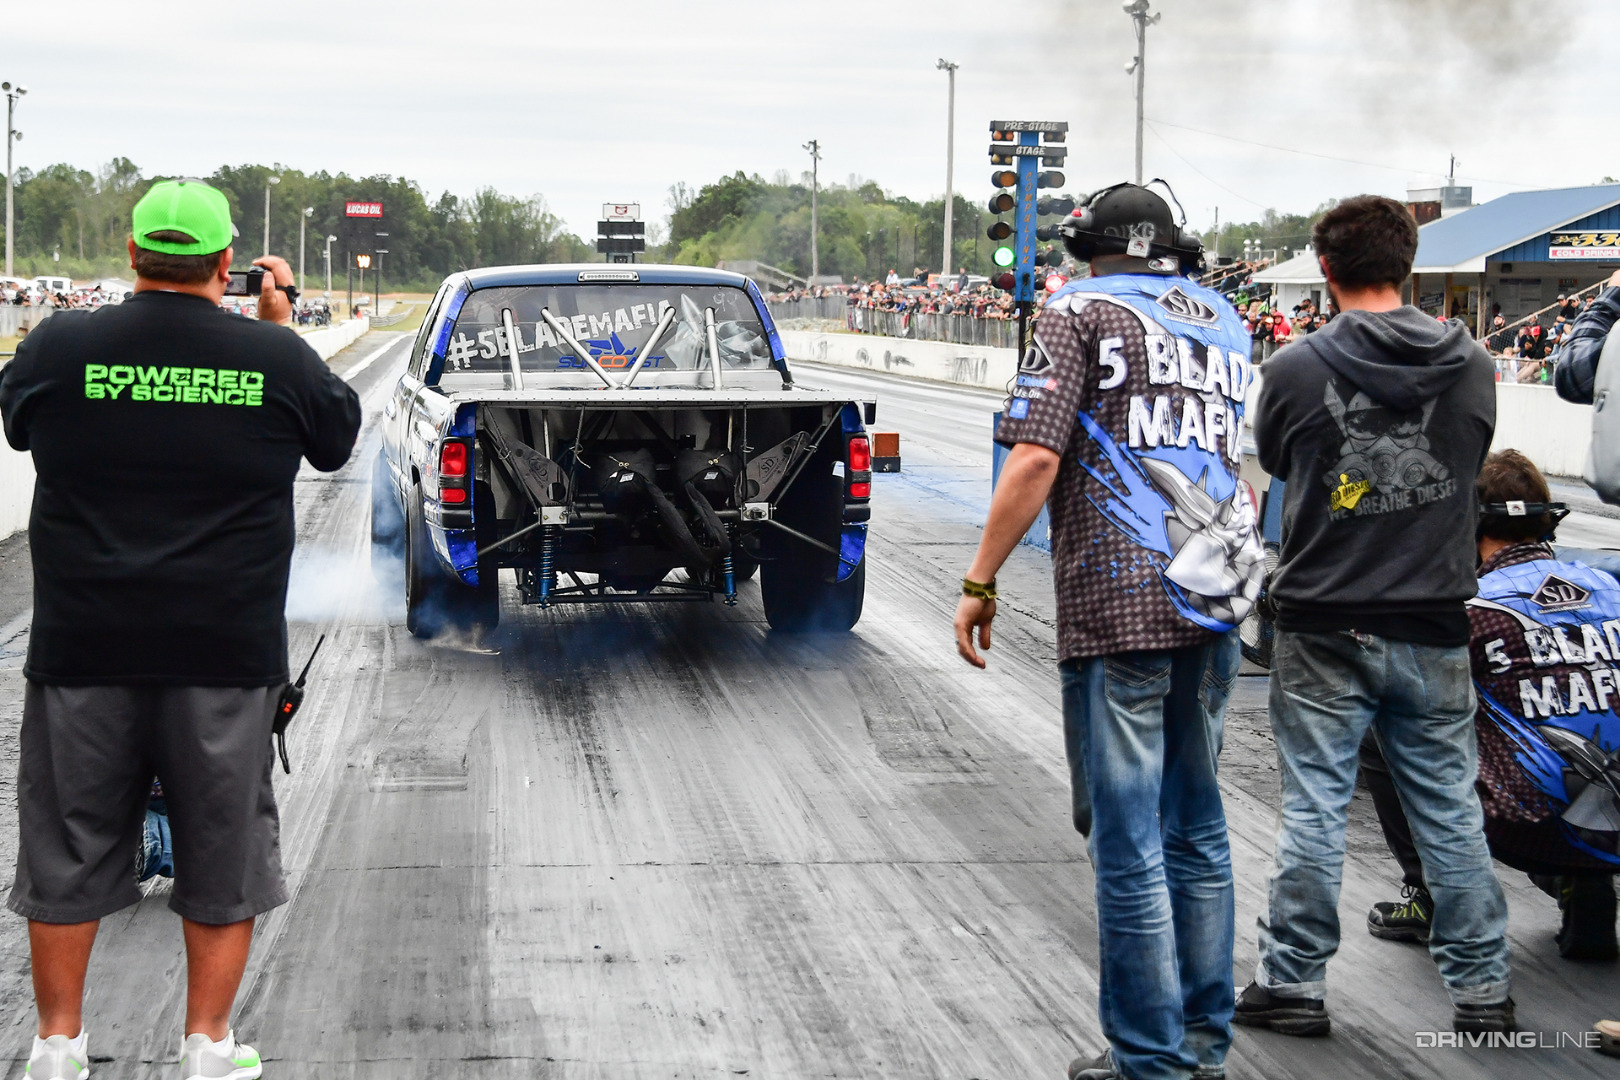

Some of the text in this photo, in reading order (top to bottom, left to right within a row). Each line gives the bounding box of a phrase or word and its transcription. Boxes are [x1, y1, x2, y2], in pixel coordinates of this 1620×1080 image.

[1004, 122, 1058, 131] PRE-STAGE
[1015, 146, 1046, 155] STAGE
[346, 204, 381, 215] LUCAS OIL
[1556, 249, 1619, 257] COLD DRINKS
[1167, 294, 1205, 318] SD
[1098, 336, 1128, 390] 5
[85, 363, 265, 391] POWERED
[85, 382, 264, 407] BY SCIENCE
[1354, 489, 1412, 516] BREATHE
[1541, 584, 1577, 604] SD
[1484, 637, 1512, 674] 5
